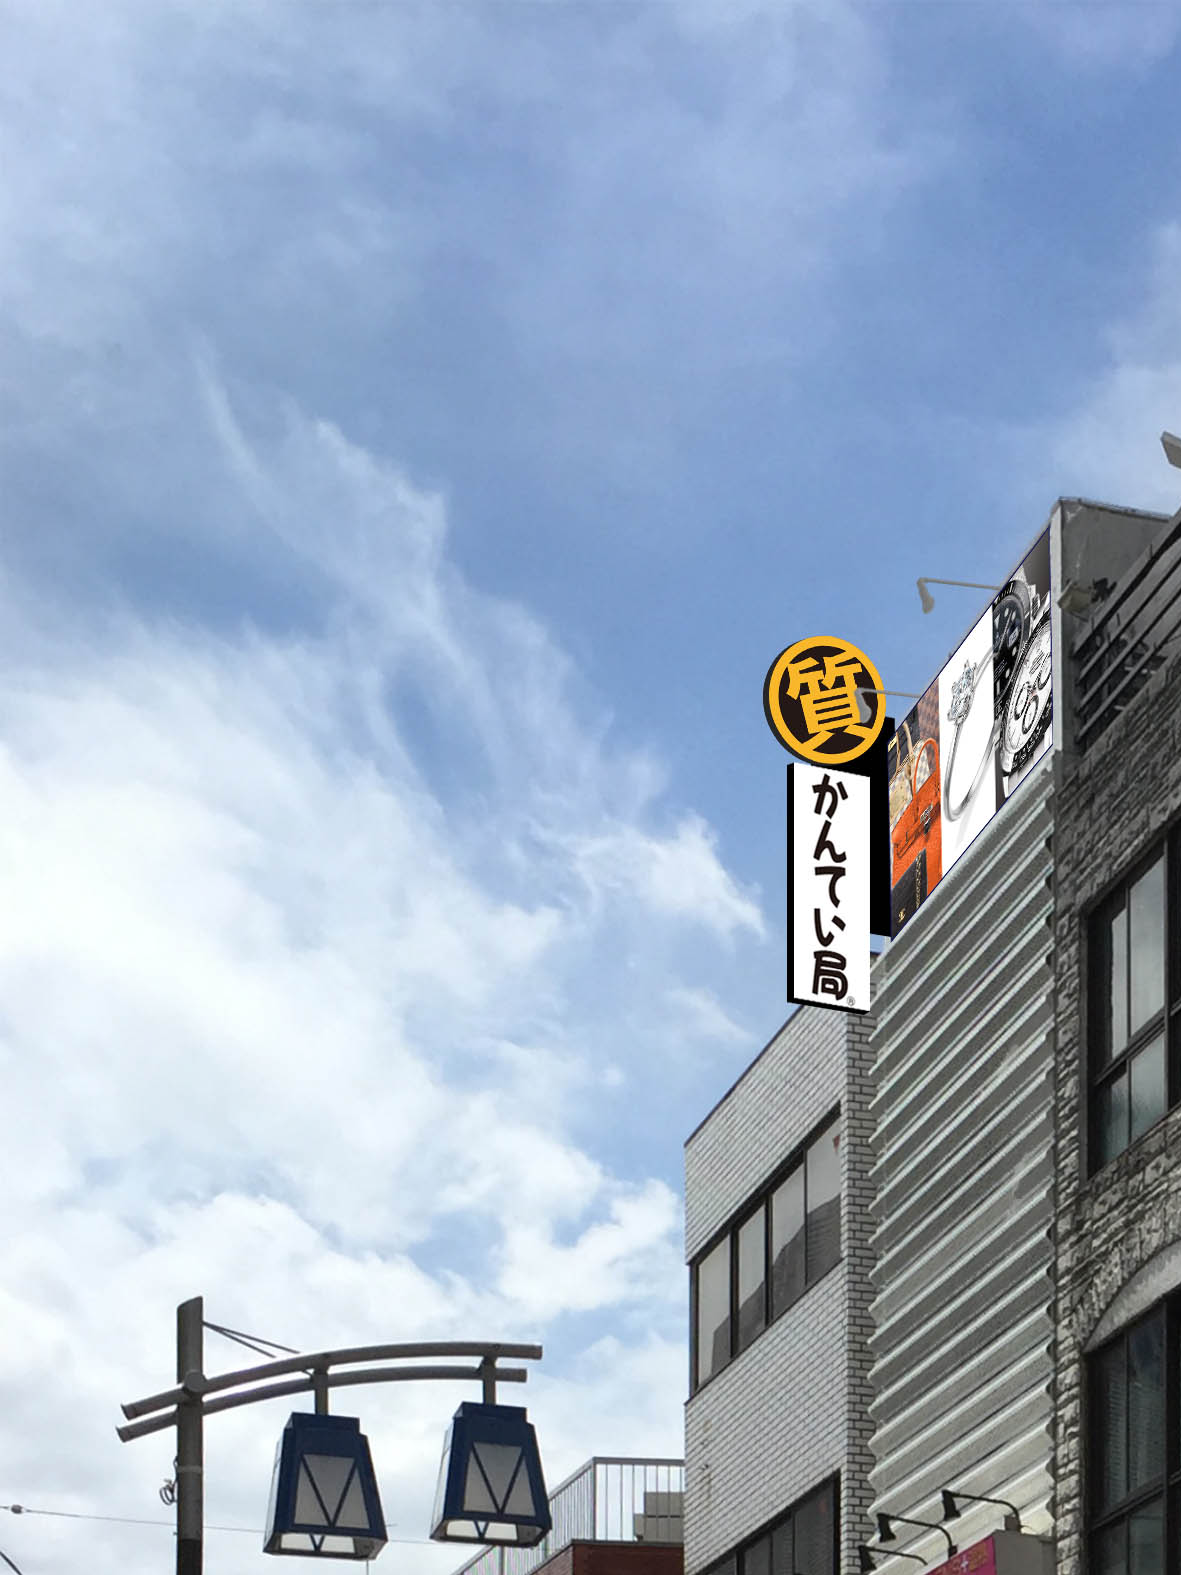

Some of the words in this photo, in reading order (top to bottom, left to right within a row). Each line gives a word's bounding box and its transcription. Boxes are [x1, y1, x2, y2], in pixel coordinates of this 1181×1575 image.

[786, 651, 870, 745] 質
[811, 773, 849, 1001] かんてい局
